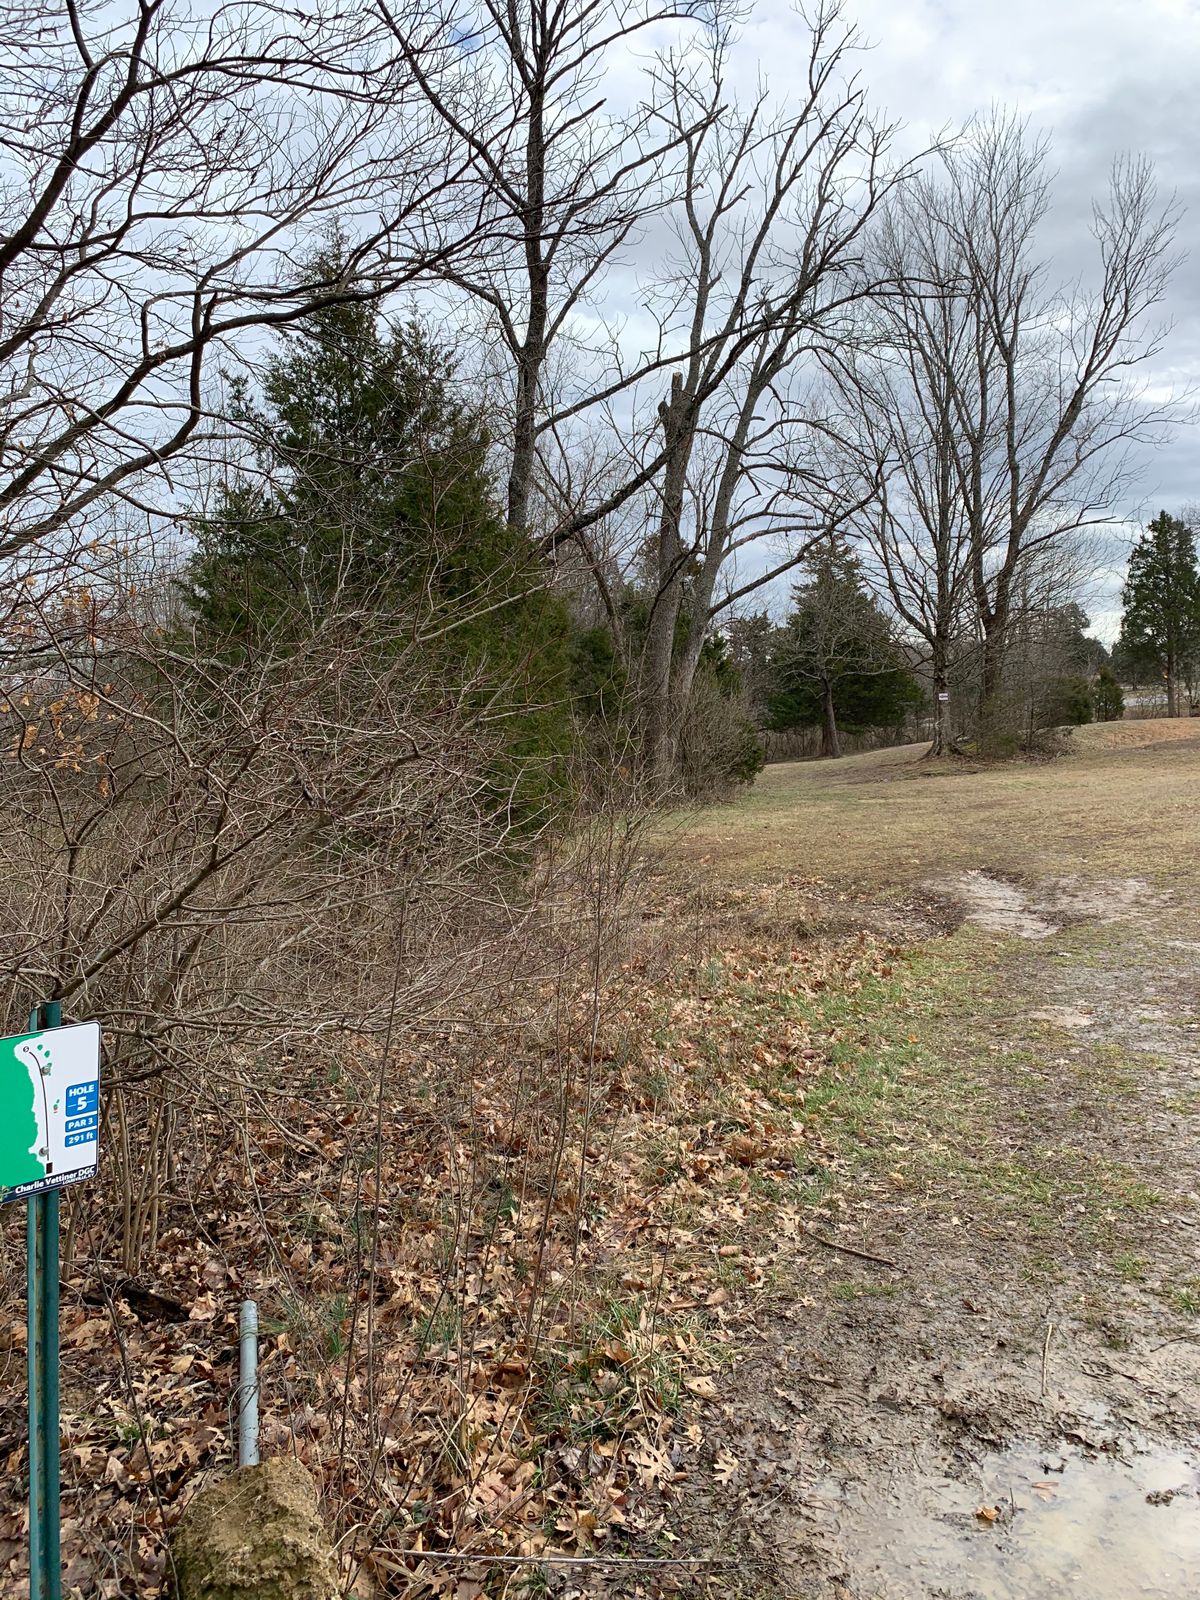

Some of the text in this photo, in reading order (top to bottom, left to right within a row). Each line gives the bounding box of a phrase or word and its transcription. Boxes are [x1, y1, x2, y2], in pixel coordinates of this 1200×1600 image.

[69, 1084, 95, 1097] HOLE
[77, 1096, 88, 1111] 5
[68, 1118, 93, 1130] PAR 3
[68, 1132, 94, 1144] 291 ft
[15, 1166, 95, 1194] Charlie Vettiner DGC
